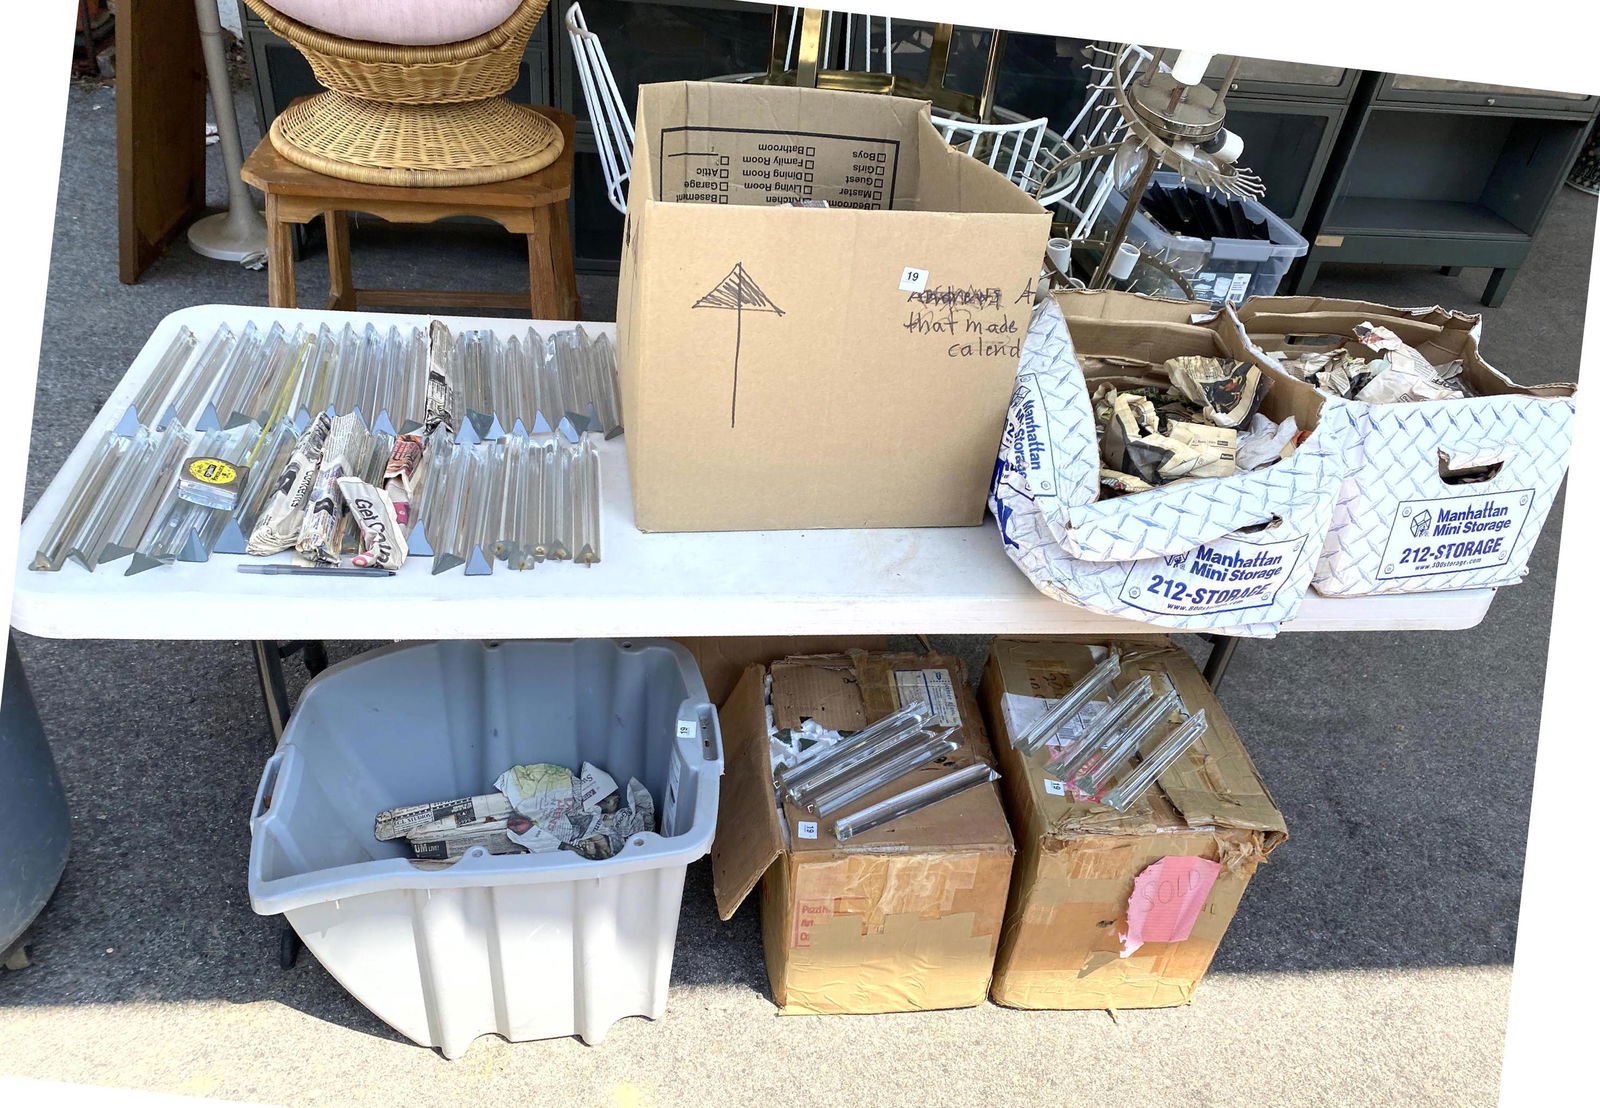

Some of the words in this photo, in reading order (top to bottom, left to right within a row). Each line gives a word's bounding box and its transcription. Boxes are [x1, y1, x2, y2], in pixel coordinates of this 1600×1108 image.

[758, 144, 804, 155] Bathroom
[742, 156, 771, 166] Room
[773, 156, 804, 167] Family
[852, 150, 875, 162] Boys
[696, 168, 719, 177] Attic
[742, 169, 771, 179] Room
[773, 169, 803, 180] Dining
[852, 164, 875, 174] Girls
[684, 179, 718, 190] Garage
[845, 175, 873, 186] Guest
[744, 182, 772, 192] Room
[774, 181, 802, 193] Living
[676, 193, 718, 203] Basement
[839, 188, 872, 198] Master
[906, 271, 920, 282] 19
[903, 308, 958, 335] that
[965, 313, 1018, 335] made
[1022, 399, 1045, 470] Manhattan
[355, 499, 379, 520] Get
[1437, 500, 1509, 523] Manhattan
[1432, 521, 1463, 537] Mini
[1462, 517, 1512, 534] Storage
[1399, 536, 1504, 564] 212-STORAGE
[1195, 544, 1283, 569] Manhattan
[1189, 561, 1228, 582] Mini
[1229, 565, 1283, 583] Storage
[1147, 574, 1273, 606] 212-STORAGE
[679, 726, 688, 734] 19
[1053, 782, 1061, 791] 19
[806, 825, 815, 834] 19
[1141, 869, 1201, 913] SOLD
